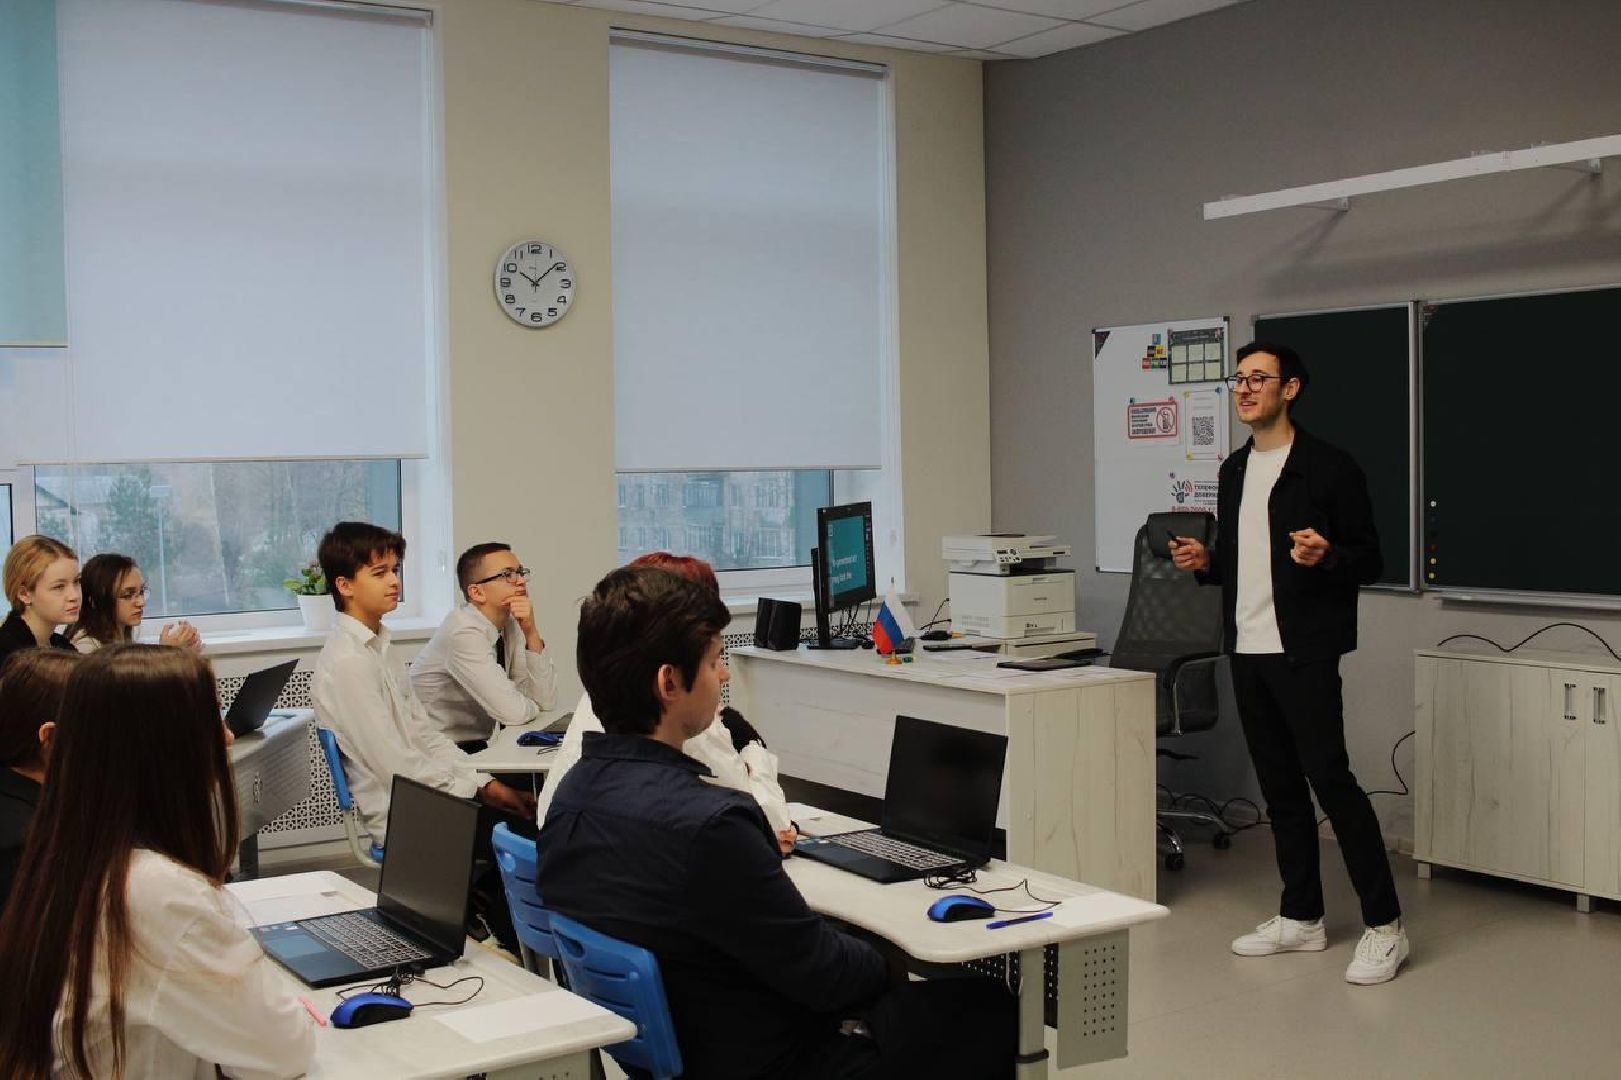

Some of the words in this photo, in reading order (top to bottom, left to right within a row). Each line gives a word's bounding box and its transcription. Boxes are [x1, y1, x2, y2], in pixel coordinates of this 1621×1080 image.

[528, 244, 542, 254] 12
[515, 250, 523, 259] 11
[504, 263, 517, 272] 10
[556, 262, 566, 272] 2
[500, 278, 511, 287] 9
[561, 279, 571, 288] 3
[505, 295, 515, 303] 8
[557, 296, 566, 304] 4
[515, 307, 526, 316] 7
[548, 308, 557, 316] 5
[531, 312, 542, 322] 6
